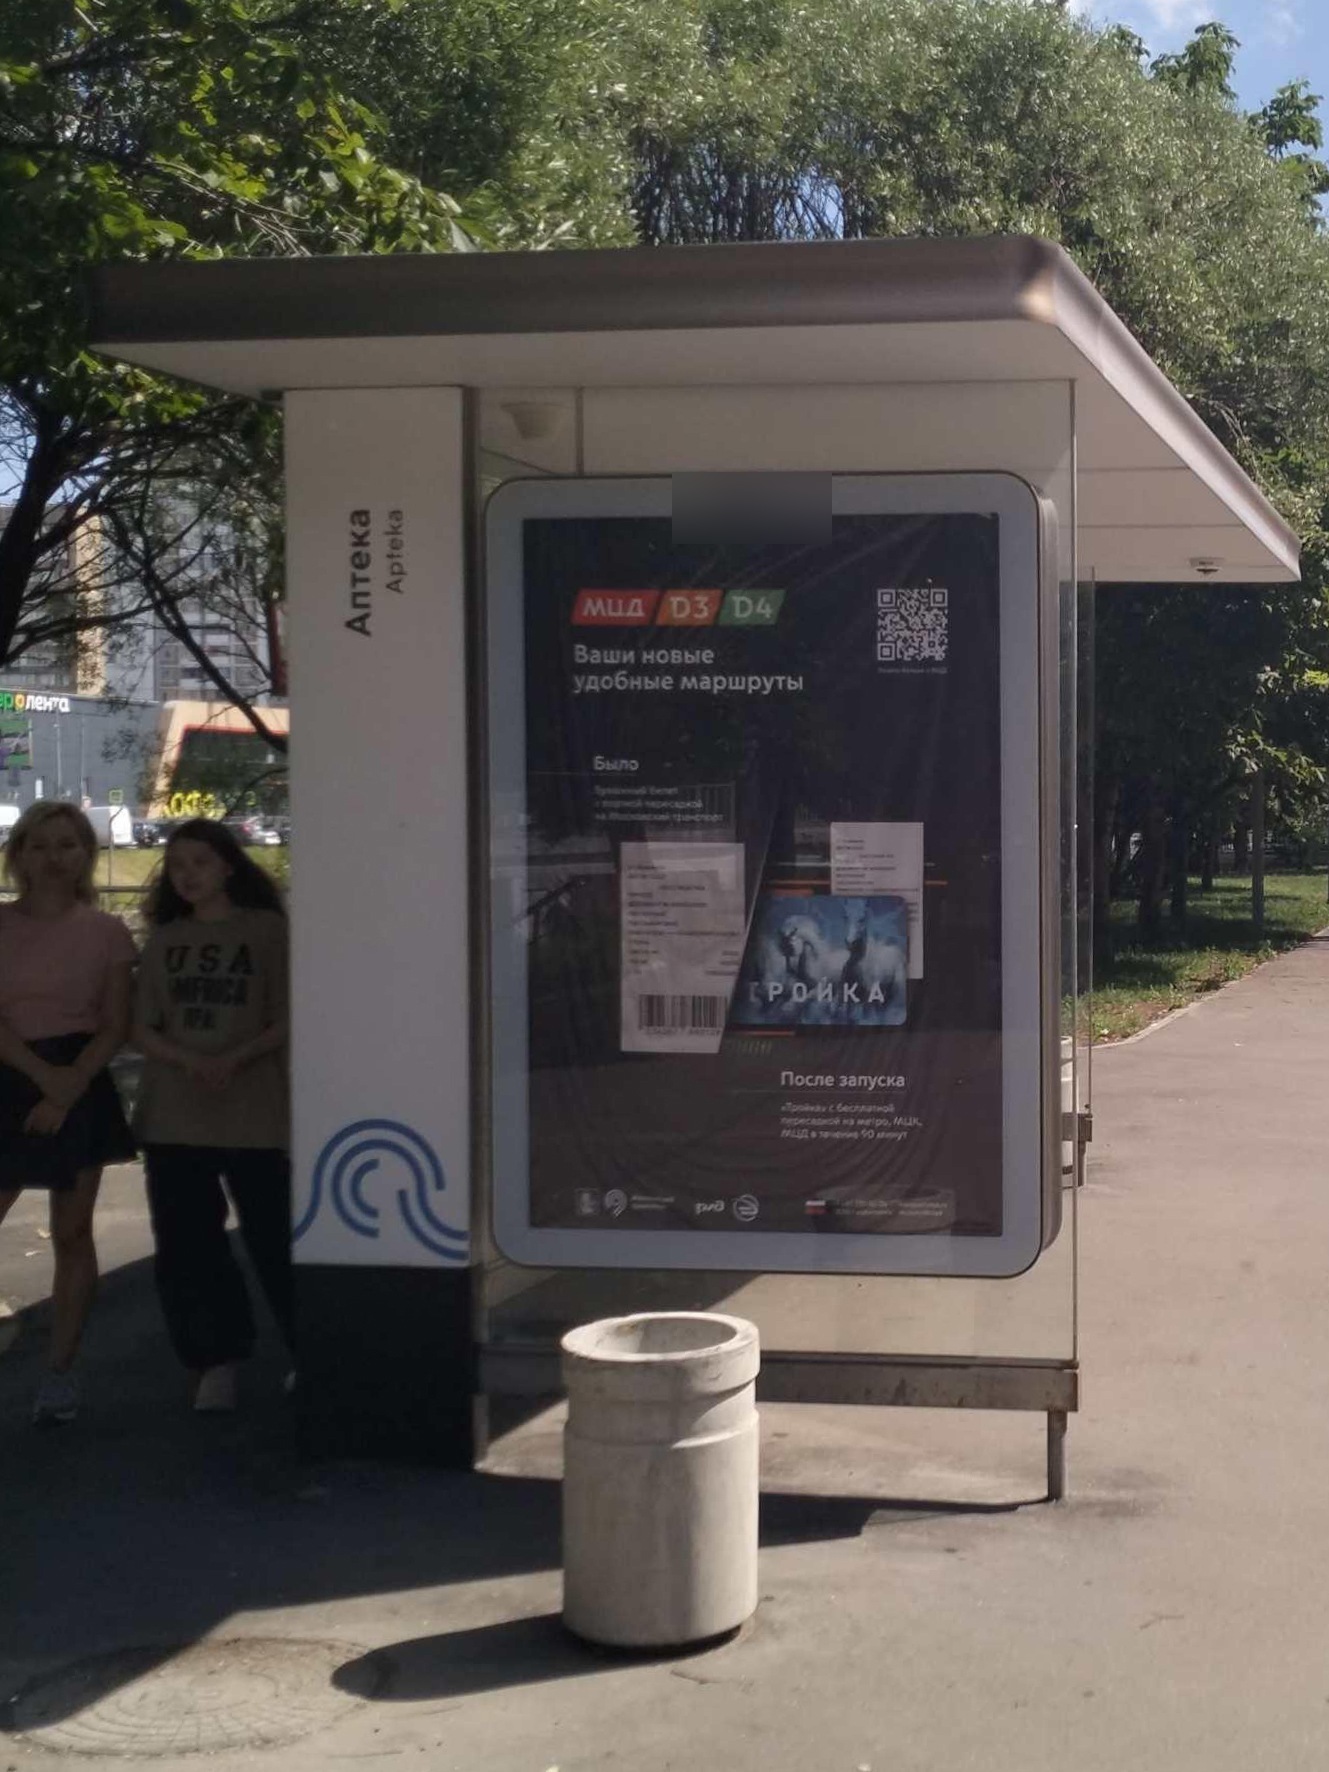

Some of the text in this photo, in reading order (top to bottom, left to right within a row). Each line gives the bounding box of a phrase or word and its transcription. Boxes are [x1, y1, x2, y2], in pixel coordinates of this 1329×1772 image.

[384, 510, 407, 594] Apteka
[345, 509, 372, 637] Аптека
[582, 596, 773, 619] МЦД D3 D4
[574, 644, 715, 664] Ваши новые
[573, 671, 804, 695] удобные маршруты
[593, 755, 640, 771] Было
[749, 976, 885, 1004] ТРОЙКА
[780, 1071, 906, 1091] После запуска
[836, 1102, 895, 1113] бесплатной
